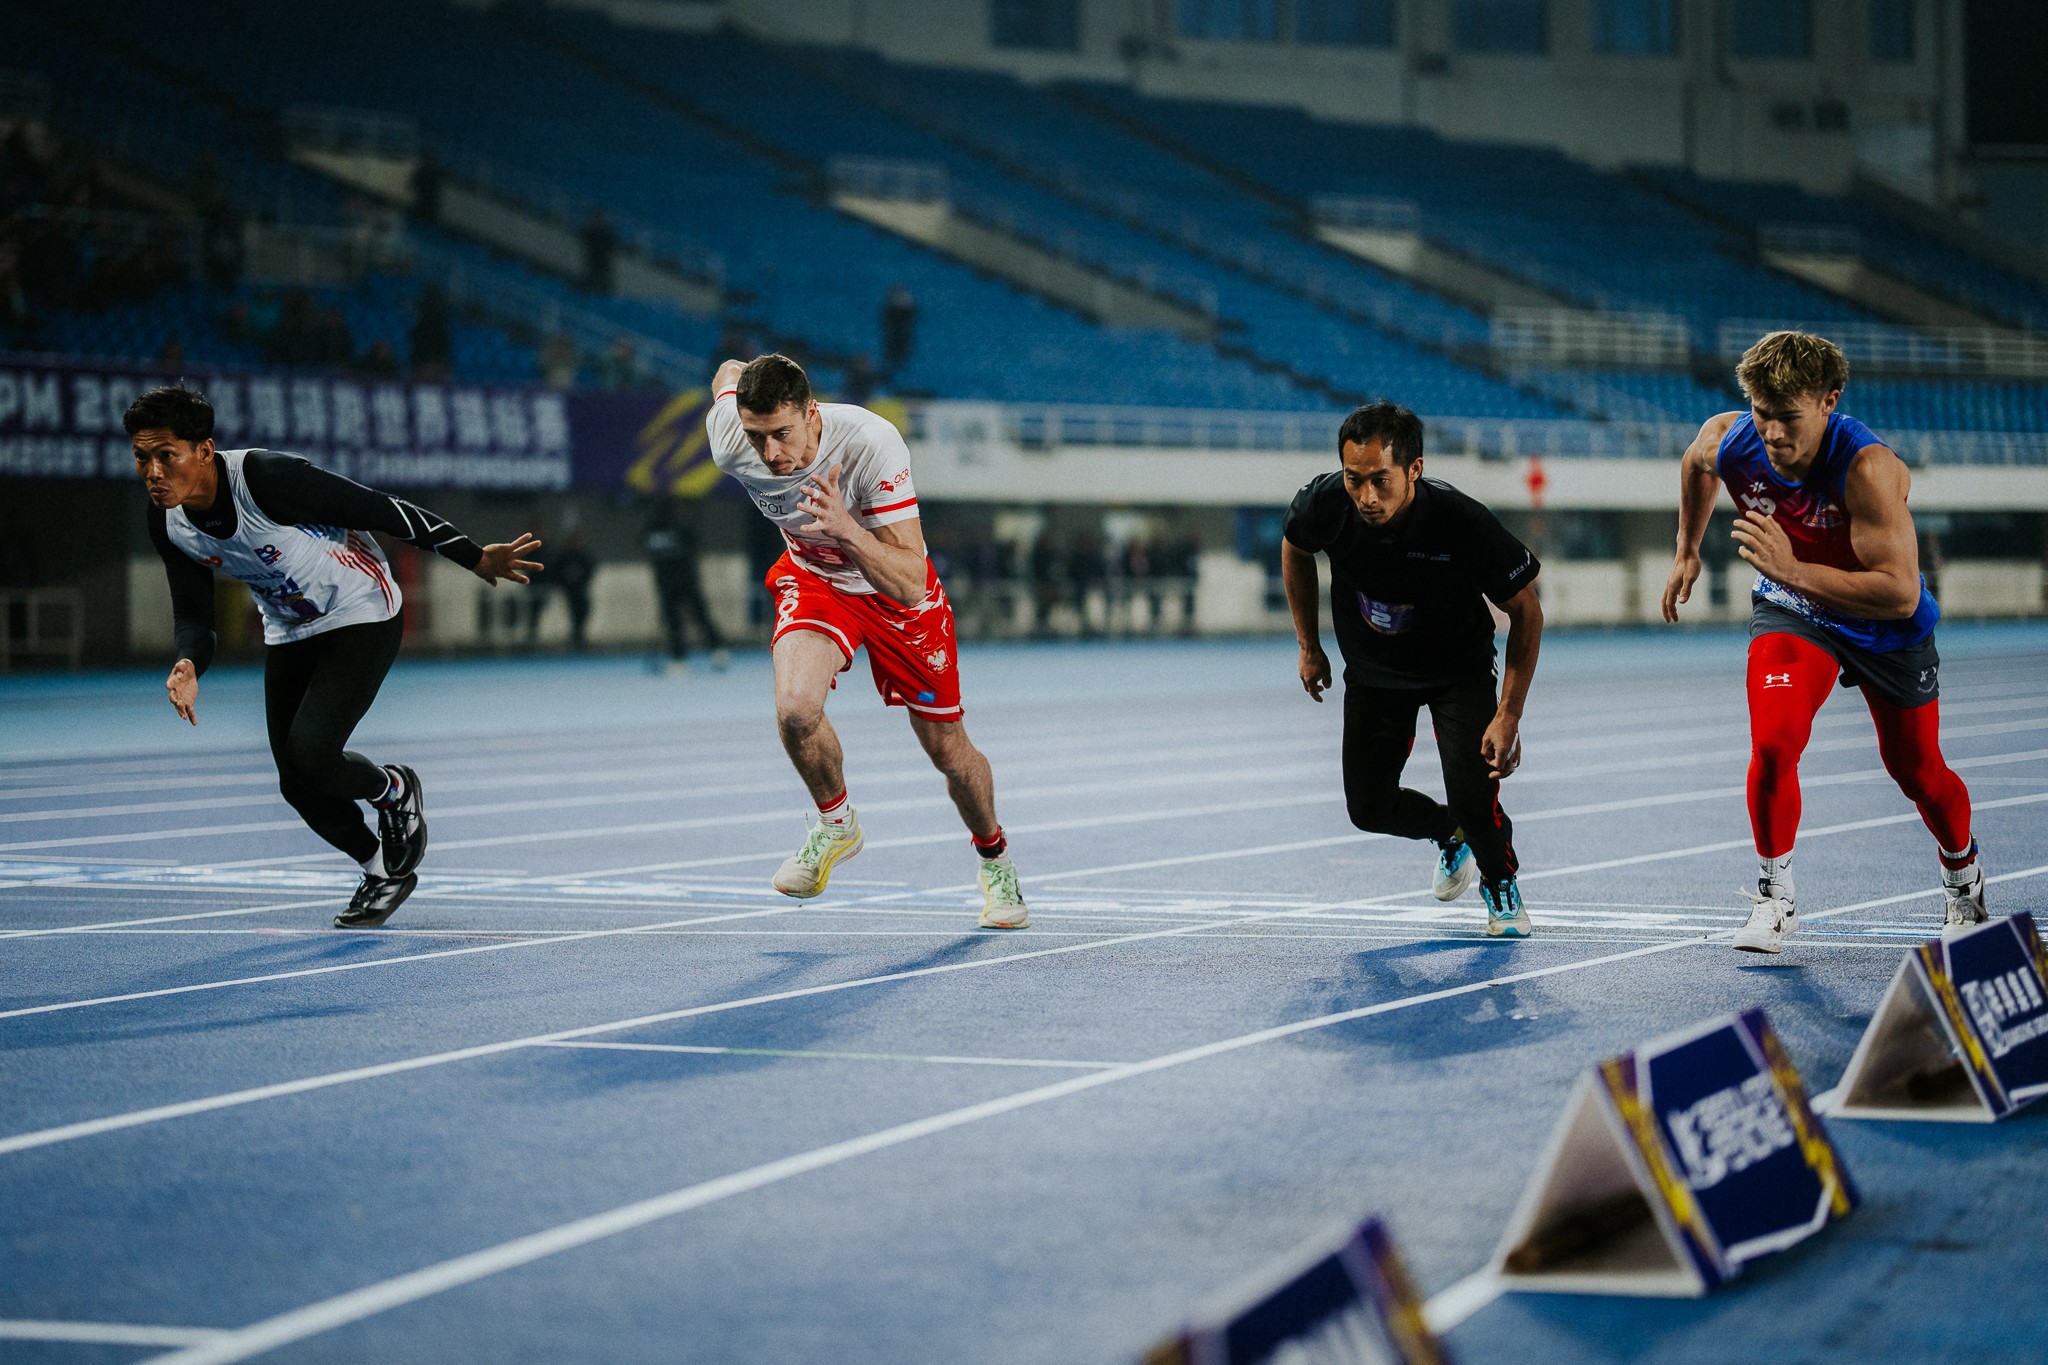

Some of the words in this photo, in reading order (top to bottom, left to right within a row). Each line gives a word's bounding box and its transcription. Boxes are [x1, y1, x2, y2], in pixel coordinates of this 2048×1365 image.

[894, 468, 909, 483] OCR
[759, 500, 789, 515] POL
[1371, 608, 1392, 629] 2
